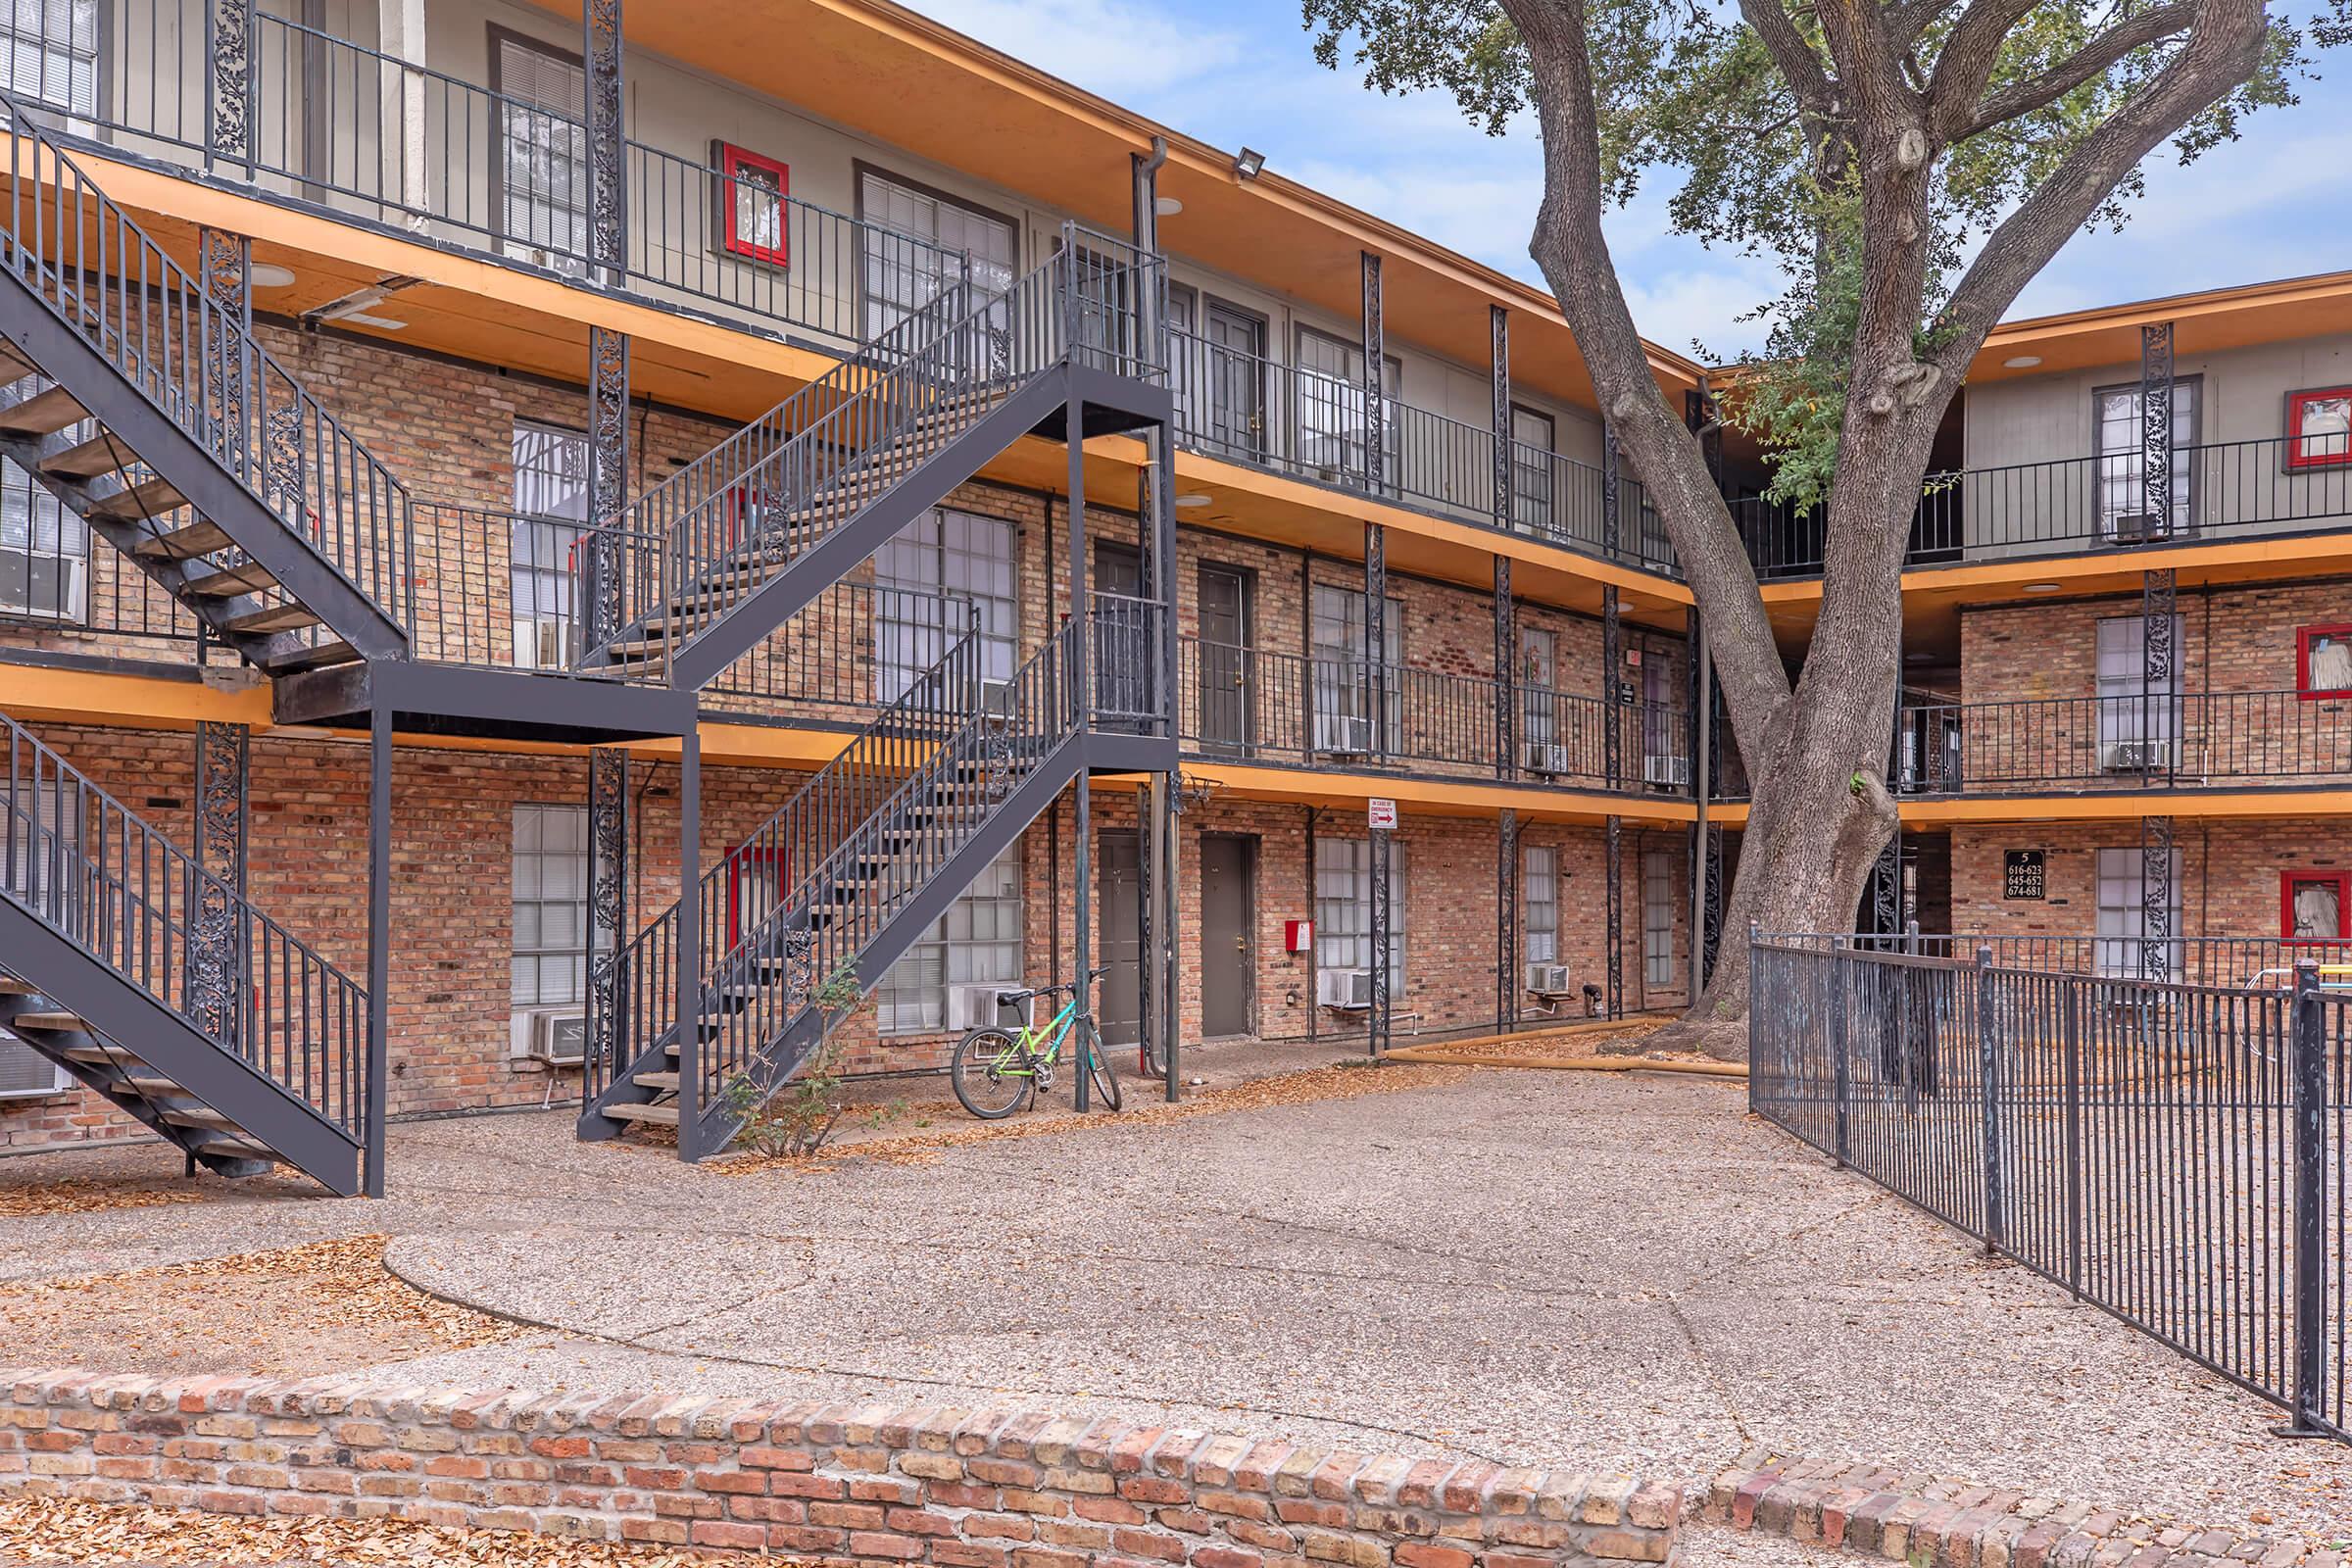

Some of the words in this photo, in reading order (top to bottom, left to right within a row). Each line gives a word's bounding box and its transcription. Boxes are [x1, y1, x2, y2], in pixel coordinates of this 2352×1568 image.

[2022, 853, 2029, 862] 5
[2008, 864, 2042, 875] 616-623
[2008, 875, 2042, 886] 645-652
[2008, 885, 2041, 896] 674-681
